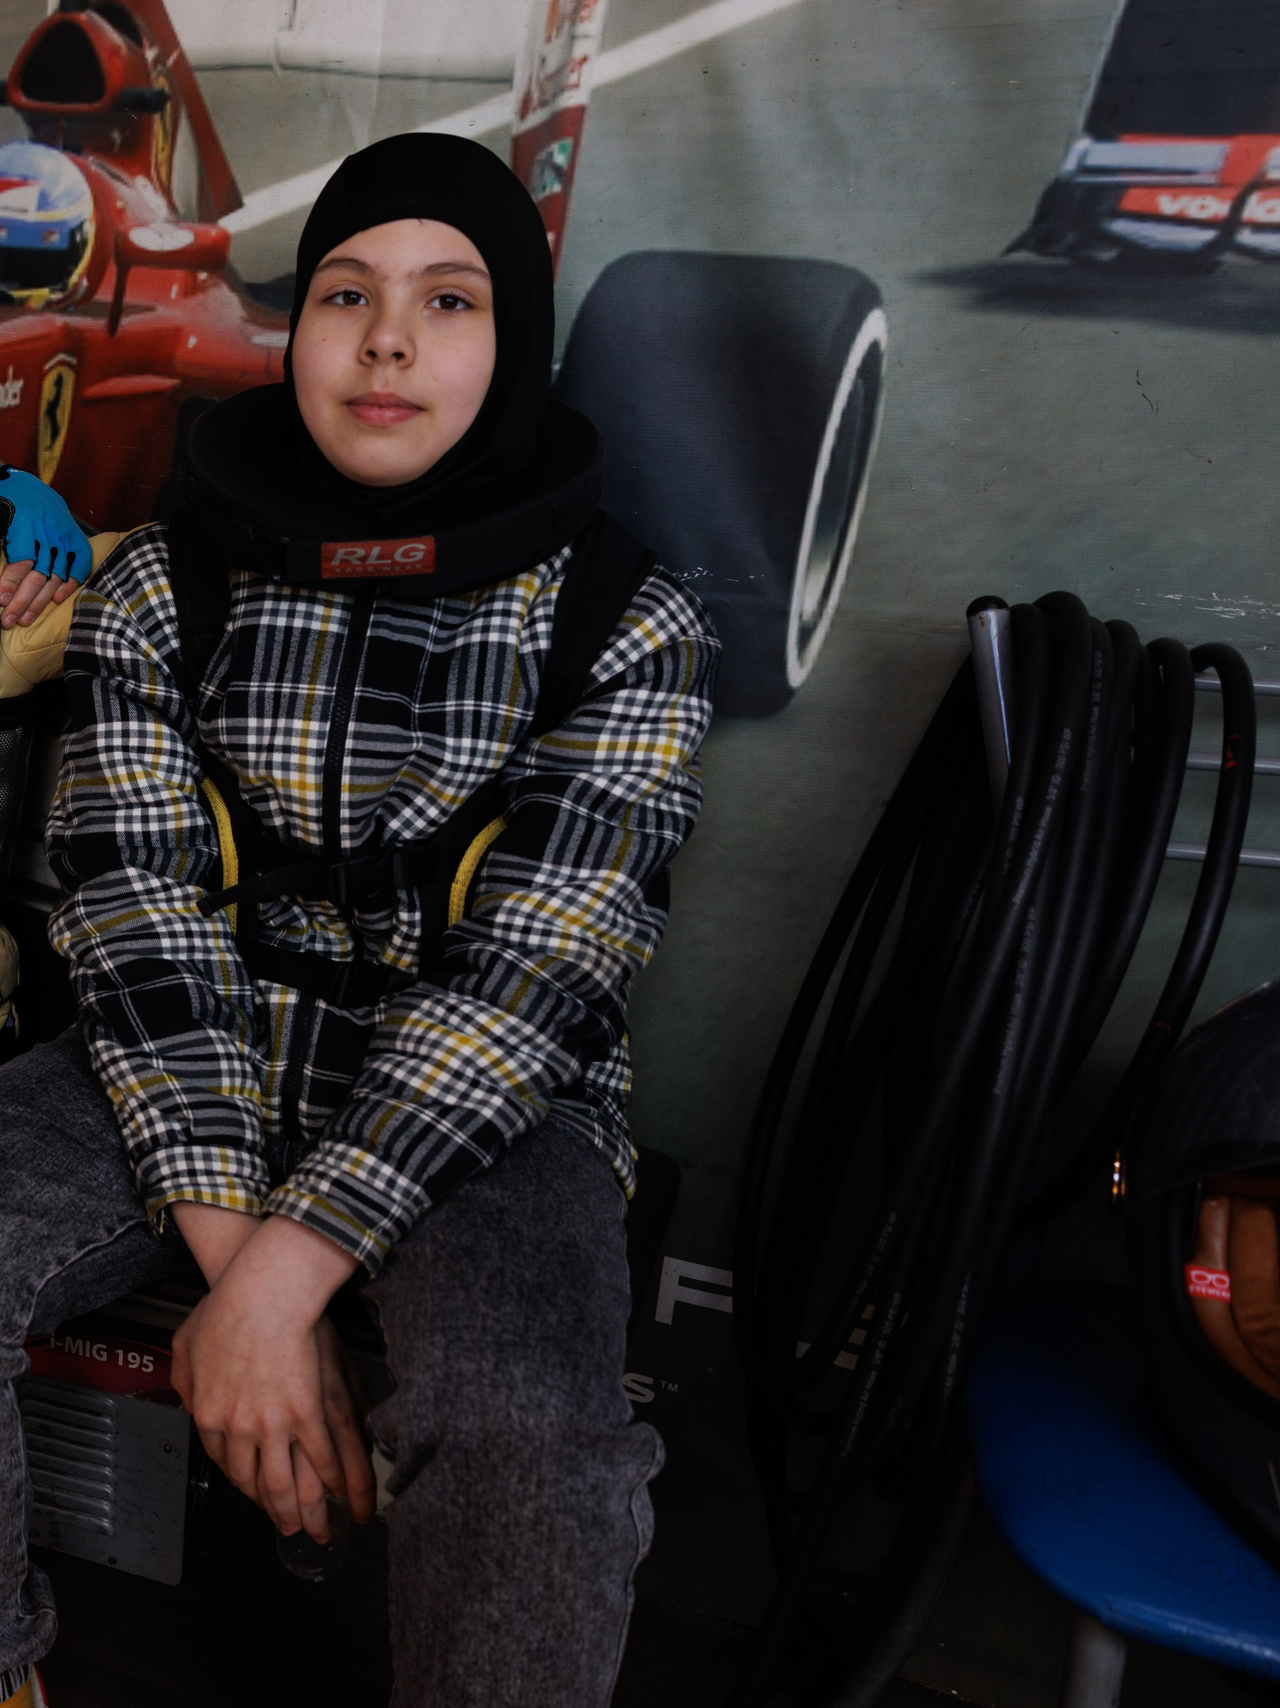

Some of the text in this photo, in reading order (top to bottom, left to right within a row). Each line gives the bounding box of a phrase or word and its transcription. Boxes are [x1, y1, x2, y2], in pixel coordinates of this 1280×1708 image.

[331, 543, 427, 565] RLG
[382, 564, 422, 572] WEAR
[50, 1333, 154, 1373] i-MIG 195
